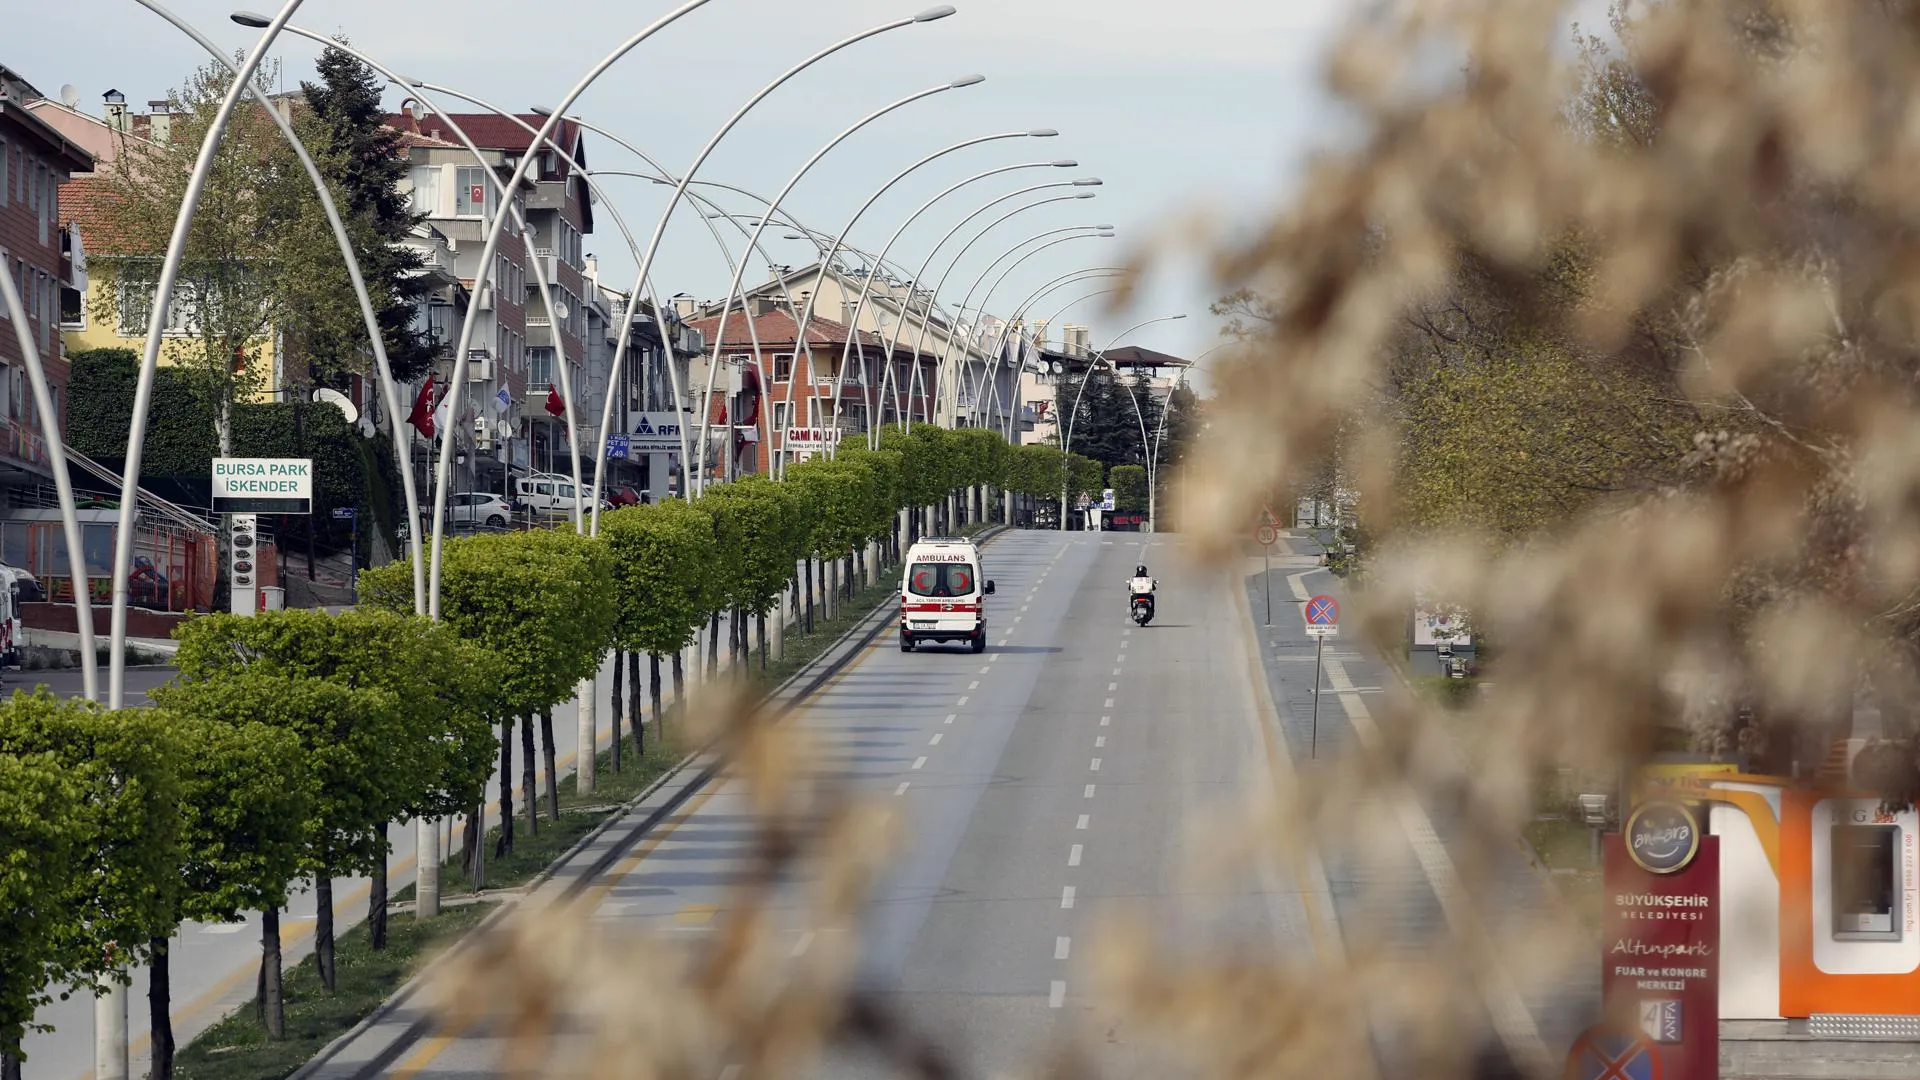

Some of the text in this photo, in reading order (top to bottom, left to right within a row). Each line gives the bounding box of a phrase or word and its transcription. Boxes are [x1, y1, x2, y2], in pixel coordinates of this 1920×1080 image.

[790, 429, 810, 441] CAMİ
[216, 463, 308, 476] BURSA PARK
[225, 477, 298, 492] İSKENDER
[916, 554, 966, 562] AMBULANS
[1615, 893, 1709, 908] BÜYÜKŞEHİR
[1621, 911, 1704, 921] BELEDİYESİ
[1611, 938, 1714, 959] Altınpark
[1615, 966, 1708, 978] FUAR ve KONGRE
[1637, 980, 1685, 991] MERKEZİ
